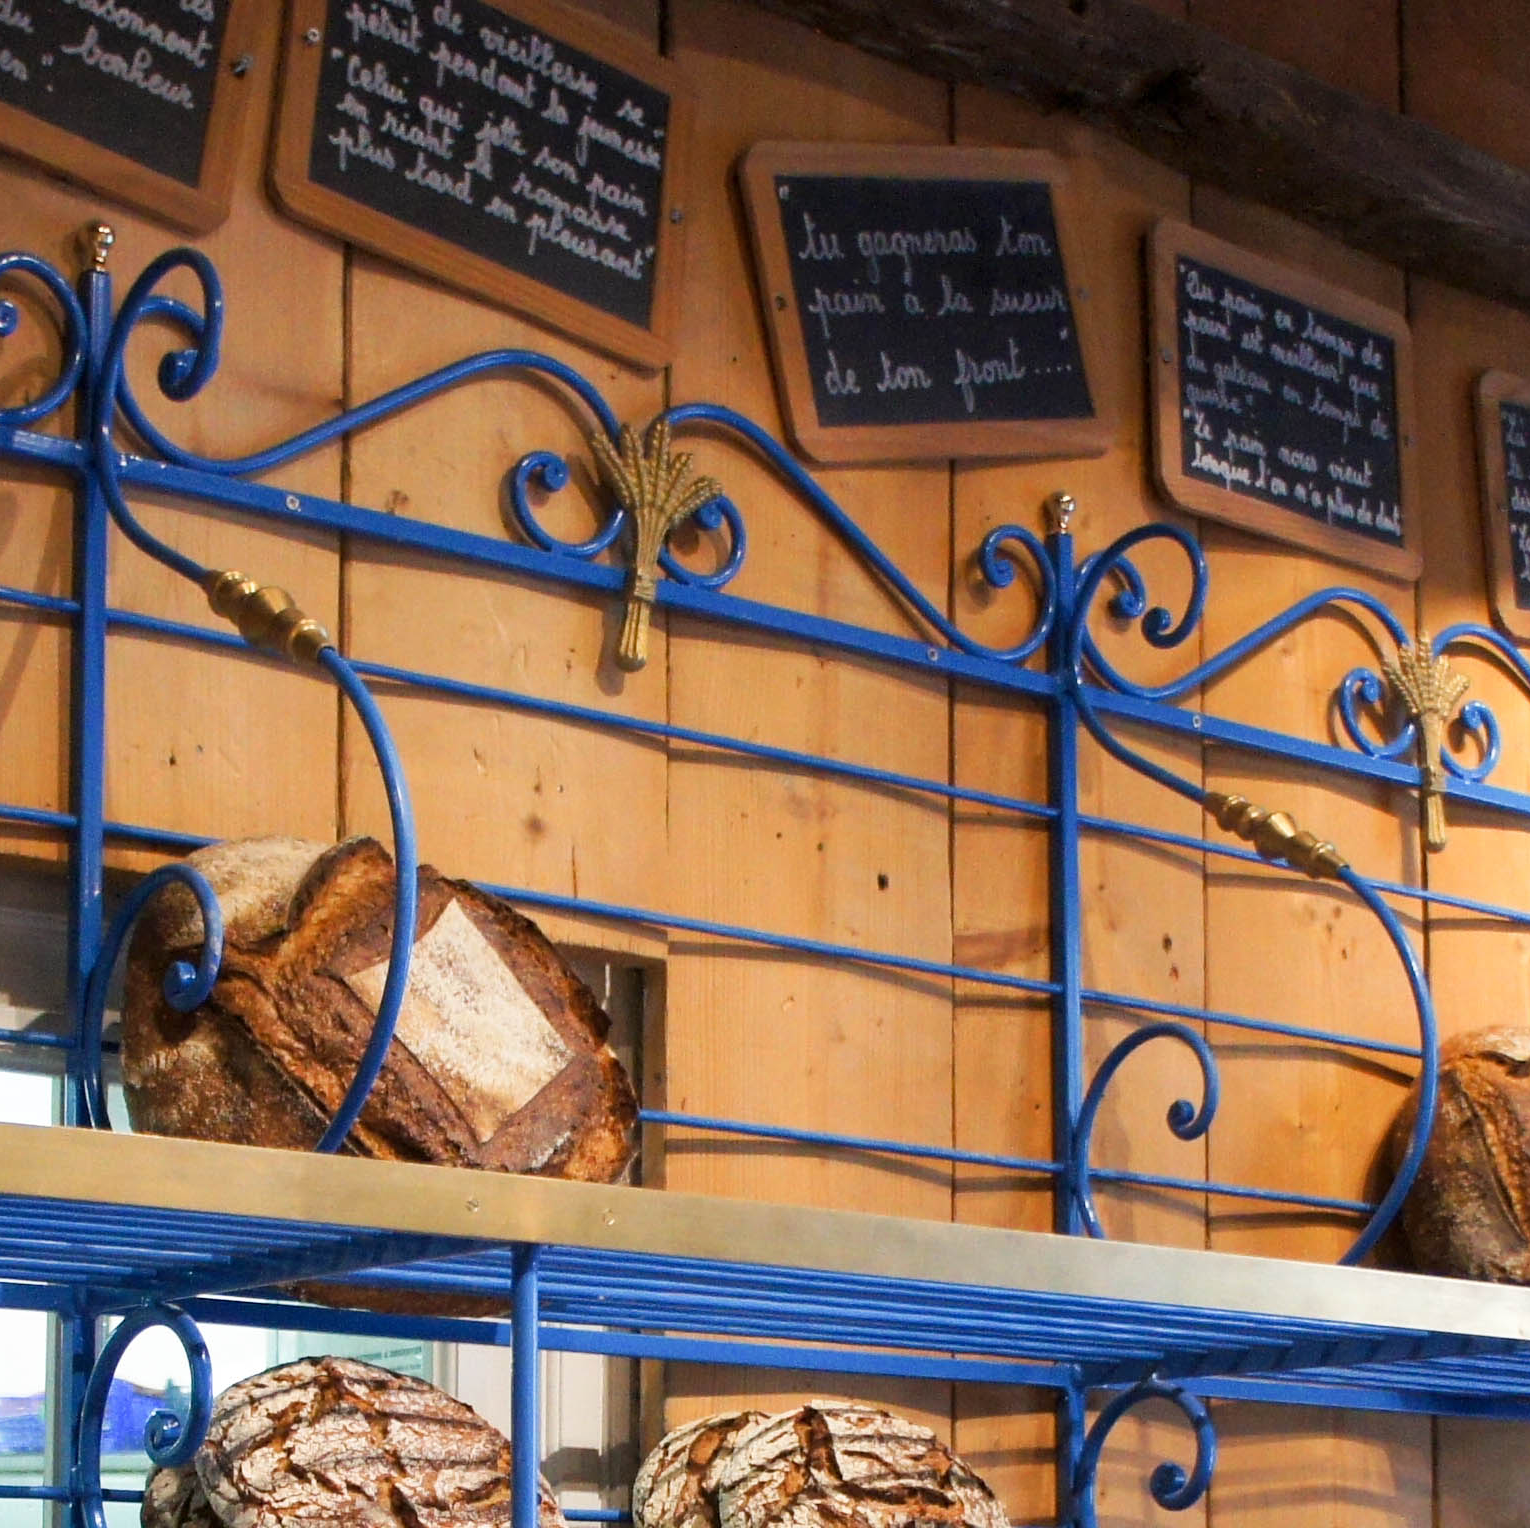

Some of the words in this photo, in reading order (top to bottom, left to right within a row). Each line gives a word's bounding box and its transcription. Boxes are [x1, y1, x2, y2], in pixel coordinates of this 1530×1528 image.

[60, 24, 196, 110] bonheur
[429, 41, 537, 109] pendant
[329, 125, 396, 172] plus
[404, 153, 474, 205] tard
[586, 173, 647, 217] pain
[995, 215, 1053, 257] ton
[808, 277, 886, 340] pain
[936, 273, 975, 316] la
[989, 286, 1068, 317] sueur
[824, 350, 862, 396] de
[876, 351, 934, 393] ton
